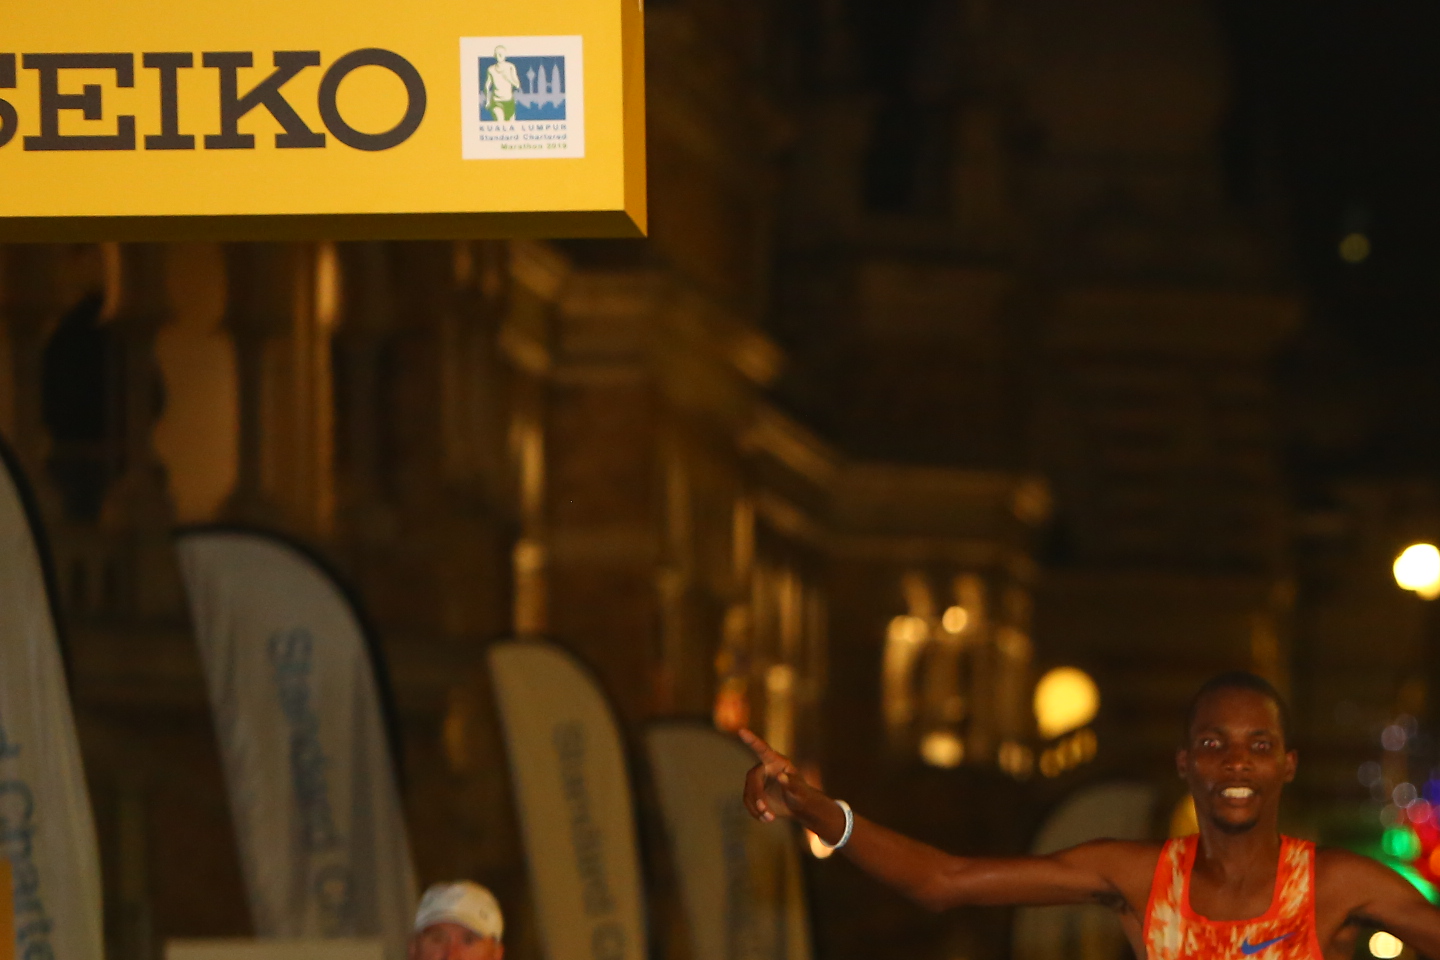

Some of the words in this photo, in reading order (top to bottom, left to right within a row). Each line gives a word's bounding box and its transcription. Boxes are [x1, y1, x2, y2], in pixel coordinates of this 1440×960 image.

[0, 47, 427, 151] EIKO
[479, 124, 515, 132] KUALA
[521, 123, 567, 131] LUMPUR
[479, 133, 519, 141] Standard
